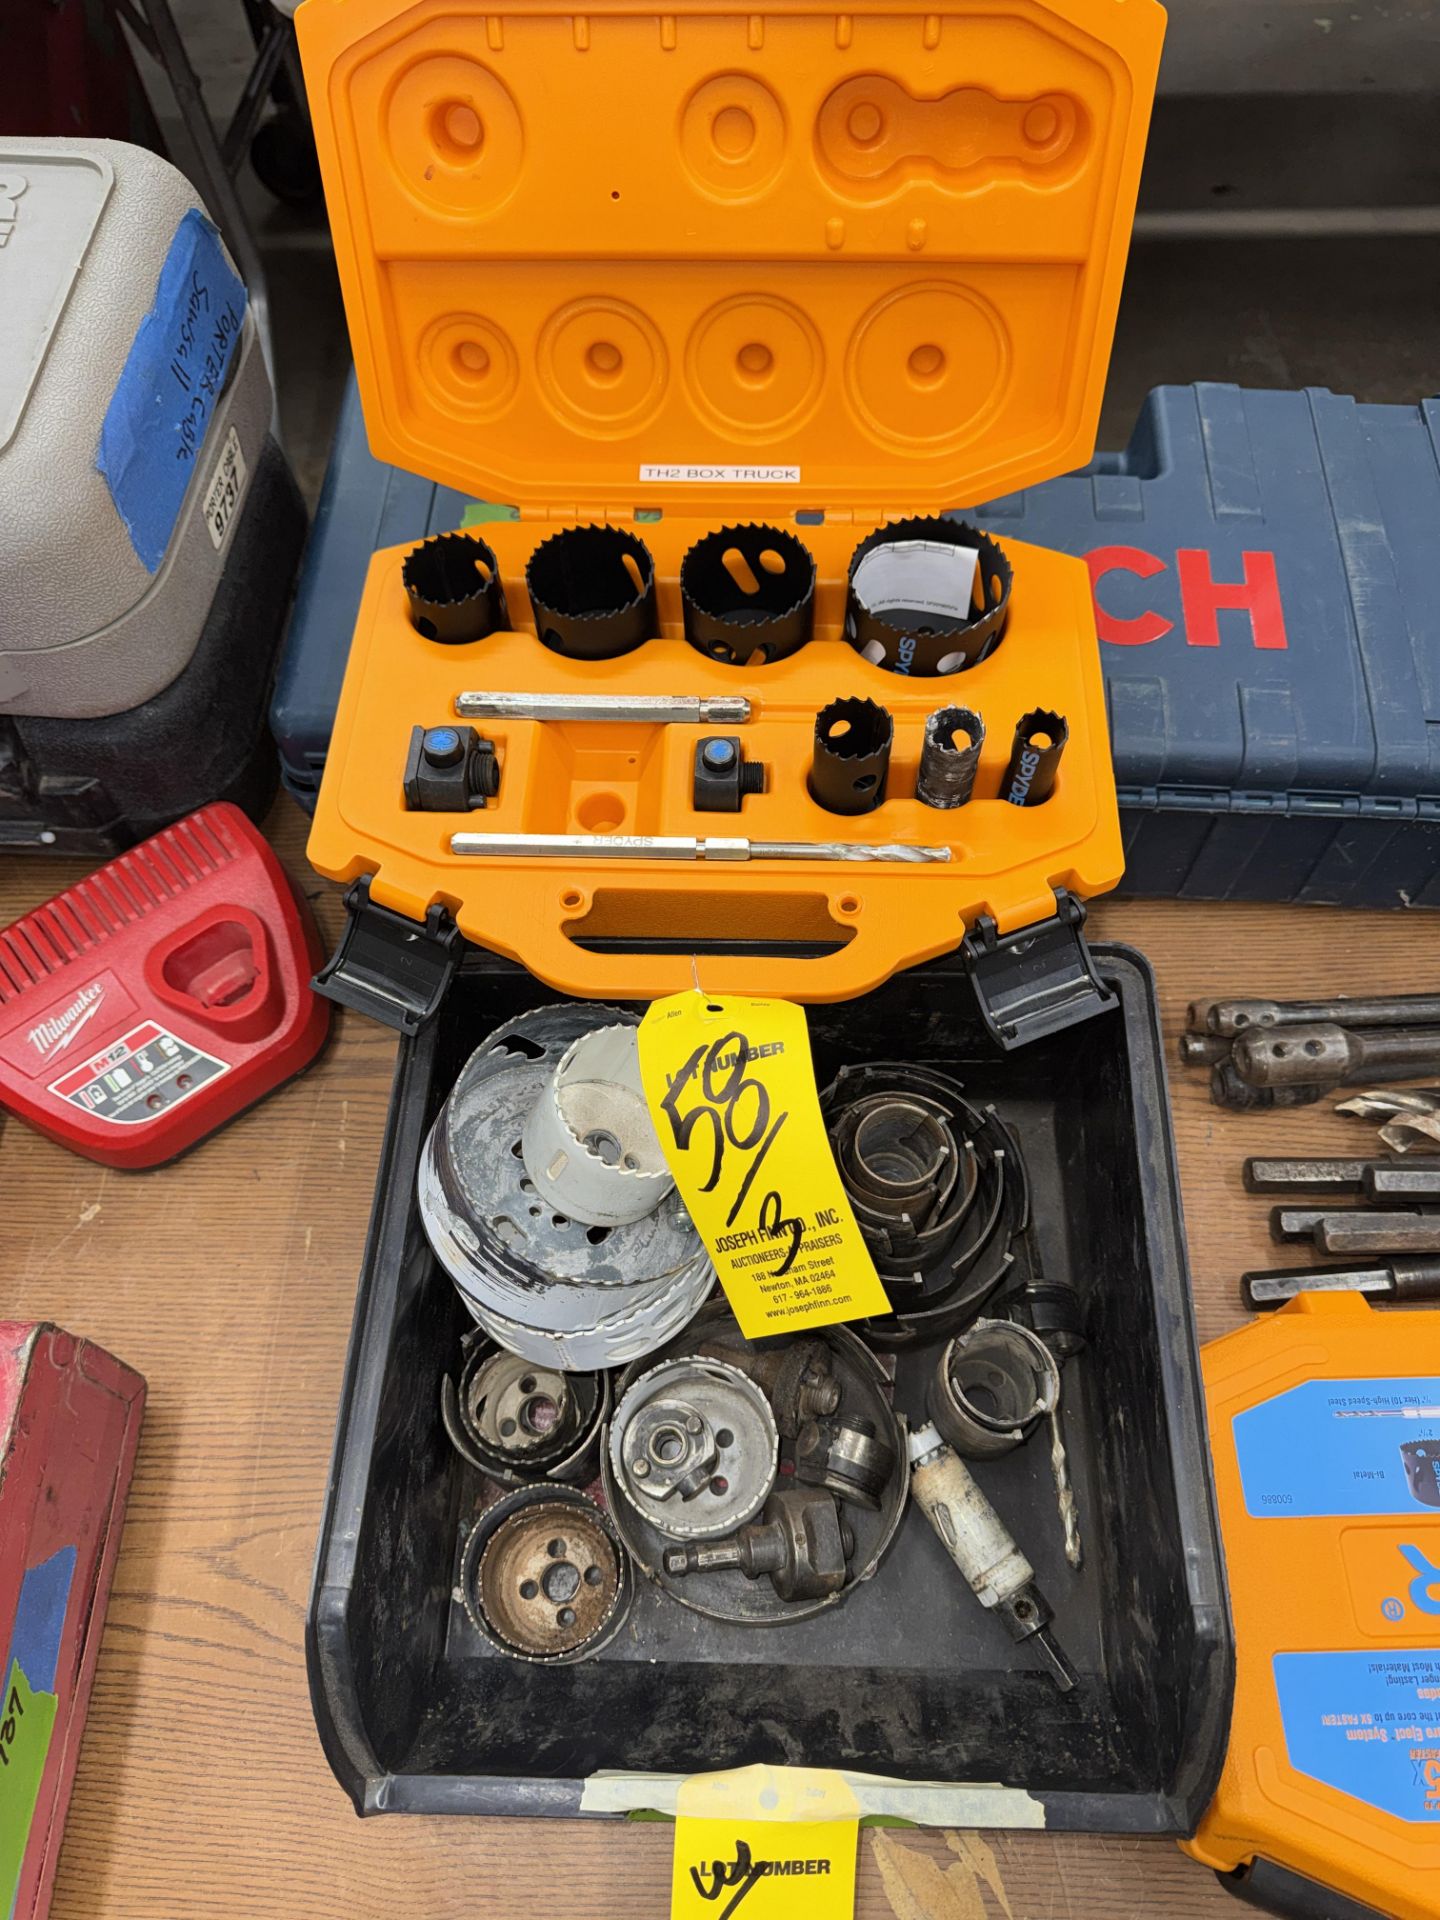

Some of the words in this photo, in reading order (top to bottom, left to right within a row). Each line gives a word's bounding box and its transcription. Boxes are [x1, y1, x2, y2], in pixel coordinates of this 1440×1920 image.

[645, 468, 681, 478] TH2
[686, 468, 727, 479] BOX
[733, 469, 797, 480] TRUCK
[214, 465, 241, 538] 9737
[894, 636, 917, 675] SPY
[592, 835, 655, 847] SPYDER
[27, 983, 105, 1054] Milwaukee
[93, 1045, 128, 1071] M12
[665, 1064, 700, 1089] LT
[714, 1228, 759, 1254] JOSEPH
[815, 1207, 844, 1228] INC.
[751, 1271, 767, 1283] 188
[807, 1256, 835, 1270] Street
[759, 1280, 795, 1294] Newton,
[794, 1275, 810, 1287] MA
[810, 1270, 836, 1283] 02464
[772, 1292, 787, 1304] 617
[793, 1284, 833, 1301] 964-1886
[765, 1294, 853, 1319] www.josephfinn.com
[1327, 1397, 1347, 1406] Steel
[1348, 1396, 1390, 1406] High-Speed
[1353, 1470, 1385, 1479] Bi-Metal
[1368, 1662, 1410, 1674] Materials!
[1412, 1662, 1433, 1672] Most
[1386, 1675, 1419, 1687] Lasting!
[1321, 1714, 1359, 1726] FASTER!
[1374, 1713, 1383, 1723] to
[1384, 1712, 1395, 1722] up
[1398, 1712, 1417, 1722] core
[1419, 1711, 1433, 1721] the
[1346, 1726, 1388, 1743] System
